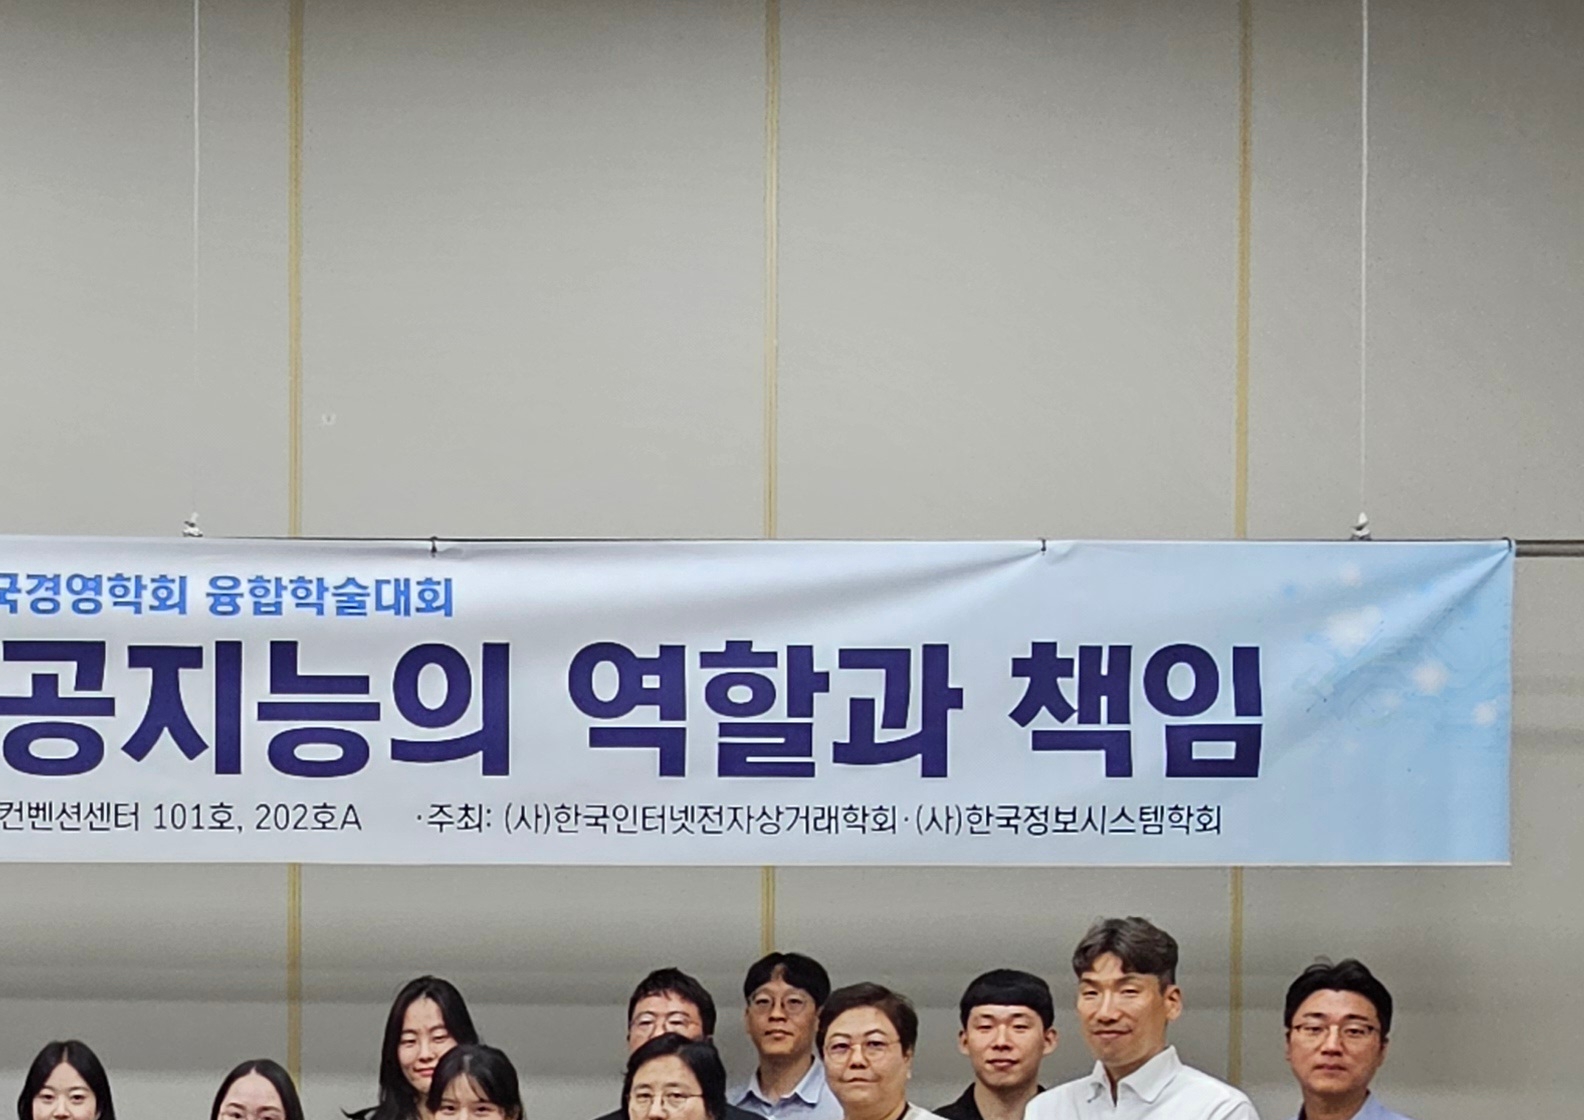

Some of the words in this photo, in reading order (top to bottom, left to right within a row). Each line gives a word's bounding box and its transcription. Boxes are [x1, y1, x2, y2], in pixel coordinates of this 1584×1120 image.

[205, 574, 453, 618] 융합학술대회
[567, 639, 964, 778] 역할과
[1008, 640, 1264, 779] 책임
[154, 801, 243, 834] 101호,
[255, 801, 362, 832] 202호A
